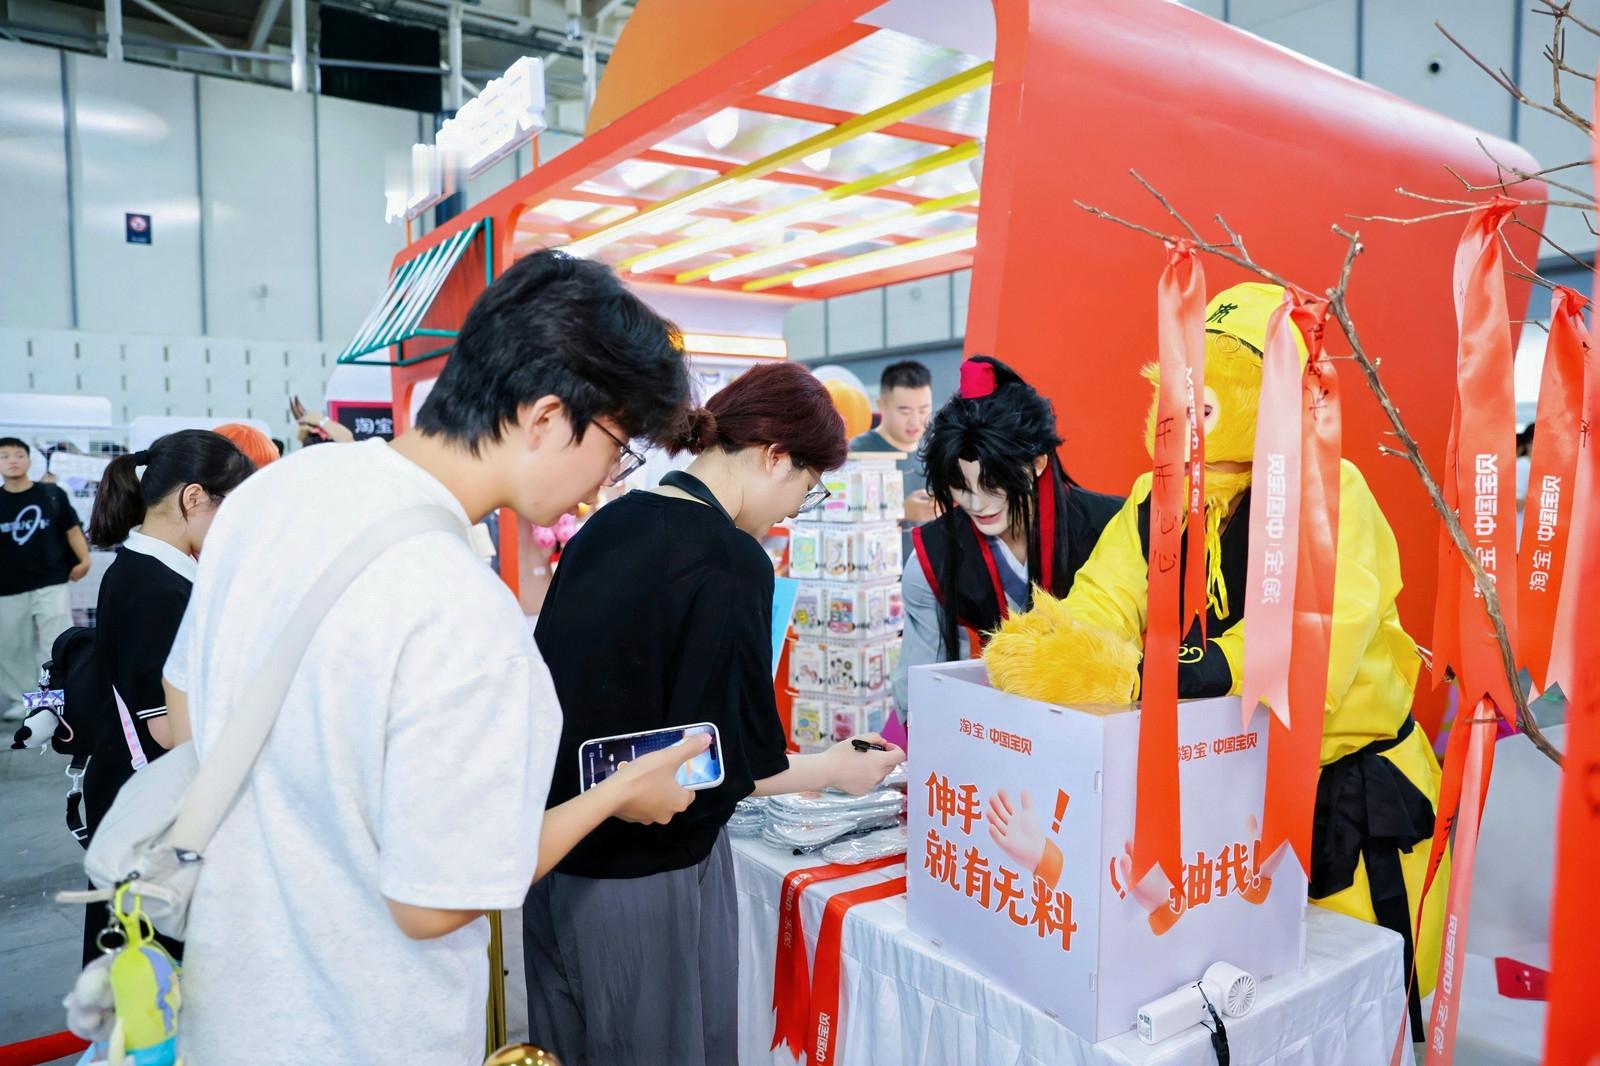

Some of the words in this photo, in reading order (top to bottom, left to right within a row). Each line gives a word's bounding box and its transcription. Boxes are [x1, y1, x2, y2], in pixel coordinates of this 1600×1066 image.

[1474, 454, 1498, 536] 中国宝贝
[1537, 475, 1562, 541] 中国宝贝
[1529, 550, 1552, 592] 淘宝
[959, 718, 985, 739] 淘宝
[989, 728, 1032, 756] 中国宝贝
[1213, 732, 1258, 755] 中国宝贝
[924, 771, 982, 835] 伸手
[924, 829, 1078, 951] 就有无料
[815, 1012, 831, 1062] 中国宝贝
